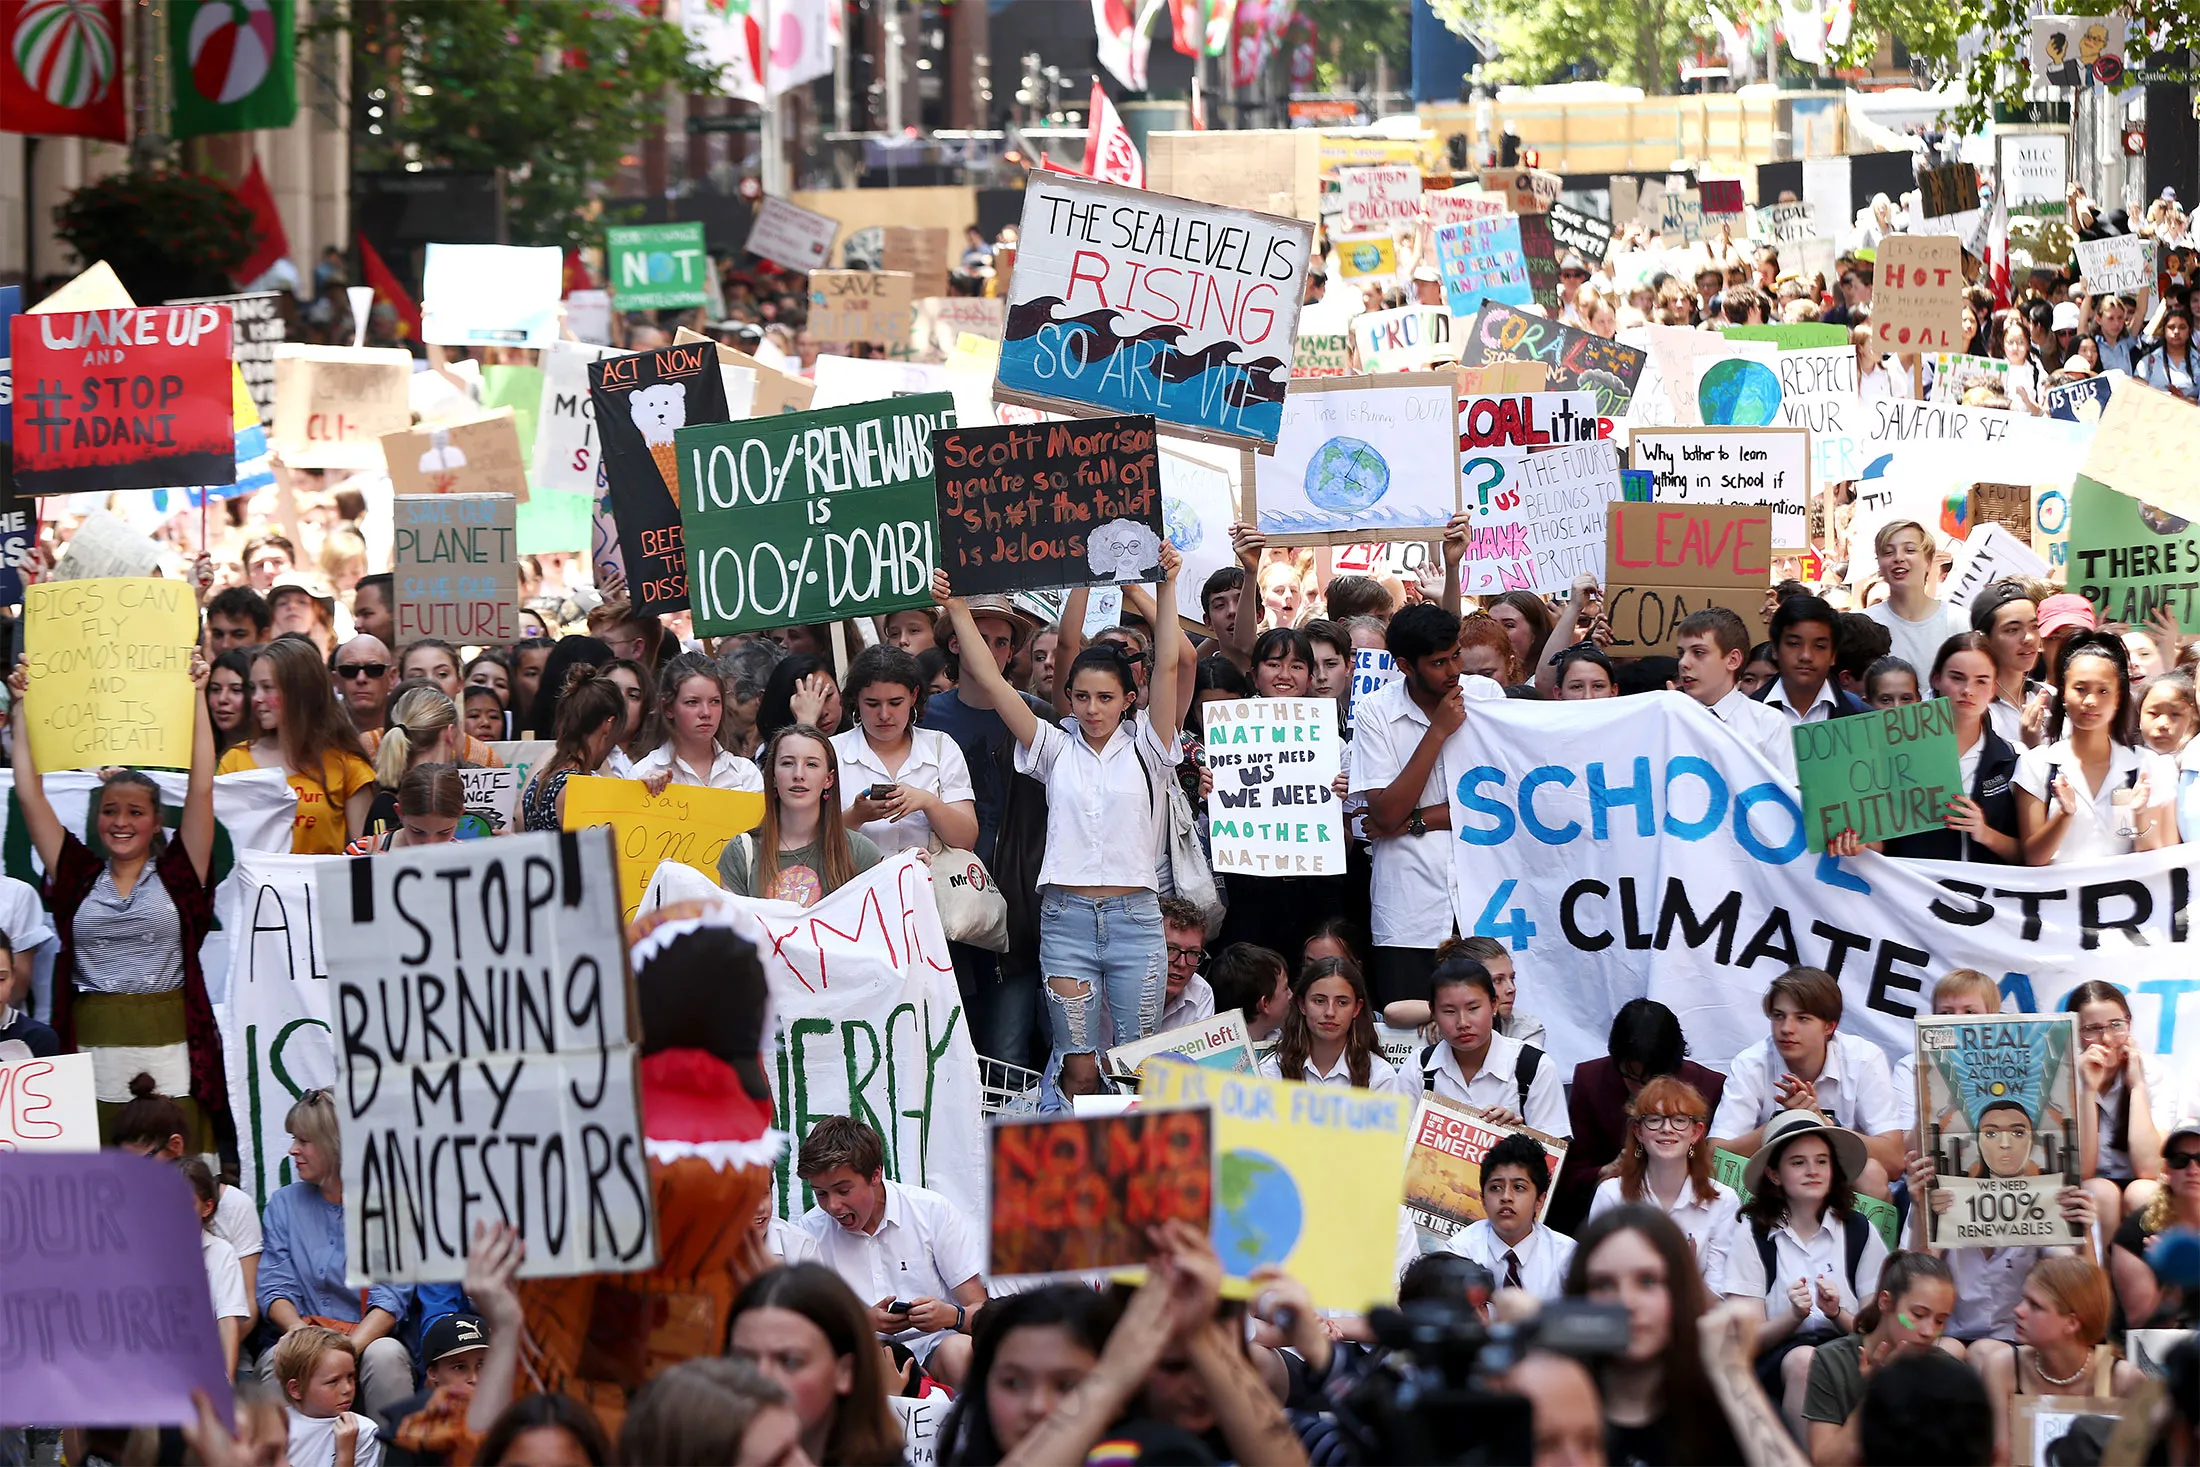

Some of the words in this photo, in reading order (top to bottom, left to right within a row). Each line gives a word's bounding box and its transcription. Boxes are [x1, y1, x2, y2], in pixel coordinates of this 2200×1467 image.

[1349, 169, 1408, 185] ACTIVISM
[1349, 200, 1422, 221] EDUCATION
[1431, 194, 1473, 210] HANDS
[1772, 205, 1811, 223] COAL
[1040, 194, 1107, 244] THE
[1169, 216, 1252, 276] LEVEL
[1260, 235, 1297, 281] IS
[1440, 227, 1457, 241] NO
[829, 275, 888, 297] SAVE
[1885, 263, 1951, 289] HOT
[2088, 273, 2112, 292] ACT
[1065, 249, 1279, 346] RISING
[41, 308, 160, 351] WAKE
[166, 307, 219, 347] UP
[1480, 307, 1588, 375] CORAL
[1880, 323, 1949, 347] COAL
[82, 350, 126, 367] AND
[600, 357, 641, 388] ACT
[655, 346, 704, 379] NOW
[1033, 321, 1089, 380] SO
[1097, 338, 1180, 409] ARE
[1200, 351, 1271, 437] WE
[1780, 355, 1856, 399] RESPECT
[2049, 389, 2065, 410] IS
[2065, 382, 2099, 406] THIS
[73, 413, 178, 449] ADANI
[692, 434, 806, 513] 100%
[803, 409, 957, 495] RENEWAB
[944, 429, 1043, 469] Scott
[1683, 445, 1716, 462] bother
[1719, 447, 1730, 461] to
[1518, 457, 1560, 489] THE
[1562, 442, 1618, 479] FUTURE
[1696, 473, 1711, 488] in
[1721, 471, 1764, 489] school
[1773, 470, 1786, 489] if
[946, 467, 1025, 517] you're
[1033, 472, 1069, 492] so
[1074, 456, 1119, 487] full
[1119, 454, 1156, 493] of
[407, 500, 452, 524] SAVE
[459, 500, 496, 524] OUR
[806, 497, 832, 525] IS
[1050, 491, 1092, 524] the
[1095, 487, 1158, 519] toilet
[1525, 486, 1590, 521] BELONGS
[1594, 481, 1617, 504] TO
[1530, 514, 1577, 545] THOSE
[1614, 509, 1768, 576] LEAVE
[396, 526, 513, 565] PLANET
[957, 536, 983, 567] is
[1536, 543, 1600, 586] PROTECT
[2077, 539, 2200, 581] THERE'S
[404, 576, 450, 600] SAVE
[458, 576, 497, 600] OUR
[697, 536, 819, 622] 100%
[32, 585, 105, 627] PIGS
[117, 583, 181, 613] CAN
[1608, 586, 1712, 647] COA
[81, 616, 129, 638] FLY
[399, 602, 512, 640] FUTURE
[29, 641, 122, 679] SCOMO'S
[127, 644, 195, 672] RIGHT
[85, 676, 127, 696] AND
[51, 702, 112, 730] COAL
[117, 700, 157, 725] IS
[1206, 702, 1321, 725] MOTHER
[1882, 698, 1957, 746] BURN
[71, 726, 165, 754] GREAT!
[1208, 724, 1321, 746] NATURE
[1209, 753, 1242, 769] DOES
[1247, 752, 1273, 764] NOT
[1278, 750, 1315, 764] NEED
[1849, 752, 1918, 793] OUR
[641, 793, 690, 821] say
[1217, 787, 1262, 809] WE
[1272, 784, 1332, 807] NEED
[1818, 785, 1946, 846] FUTURE
[1211, 819, 1331, 843] MOTHER
[1217, 849, 1324, 873] NATURE
[949, 873, 968, 889] Mr
[393, 856, 556, 967] STOP
[1474, 878, 1537, 952] 4
[1205, 1026, 1235, 1048] left
[1961, 1025, 2031, 1051] REAL
[1963, 1050, 2031, 1067] CLIMATE
[1967, 1065, 2029, 1081] ACTION
[409, 1057, 526, 1132] MY
[1975, 1080, 2026, 1098] NOW
[1220, 1079, 1277, 1122] OUR
[1290, 1093, 1400, 1133] FUTURE
[1428, 1112, 1446, 1124] THIS
[1425, 1119, 1434, 1128] IS
[1435, 1121, 1443, 1131] A
[360, 1121, 649, 1276] ANCESTORS
[1976, 1181, 1997, 1192] WE
[1999, 1180, 2028, 1191] NEED
[1965, 1191, 2046, 1224] 100%
[1957, 1220, 2054, 1238] RENEWABLES
